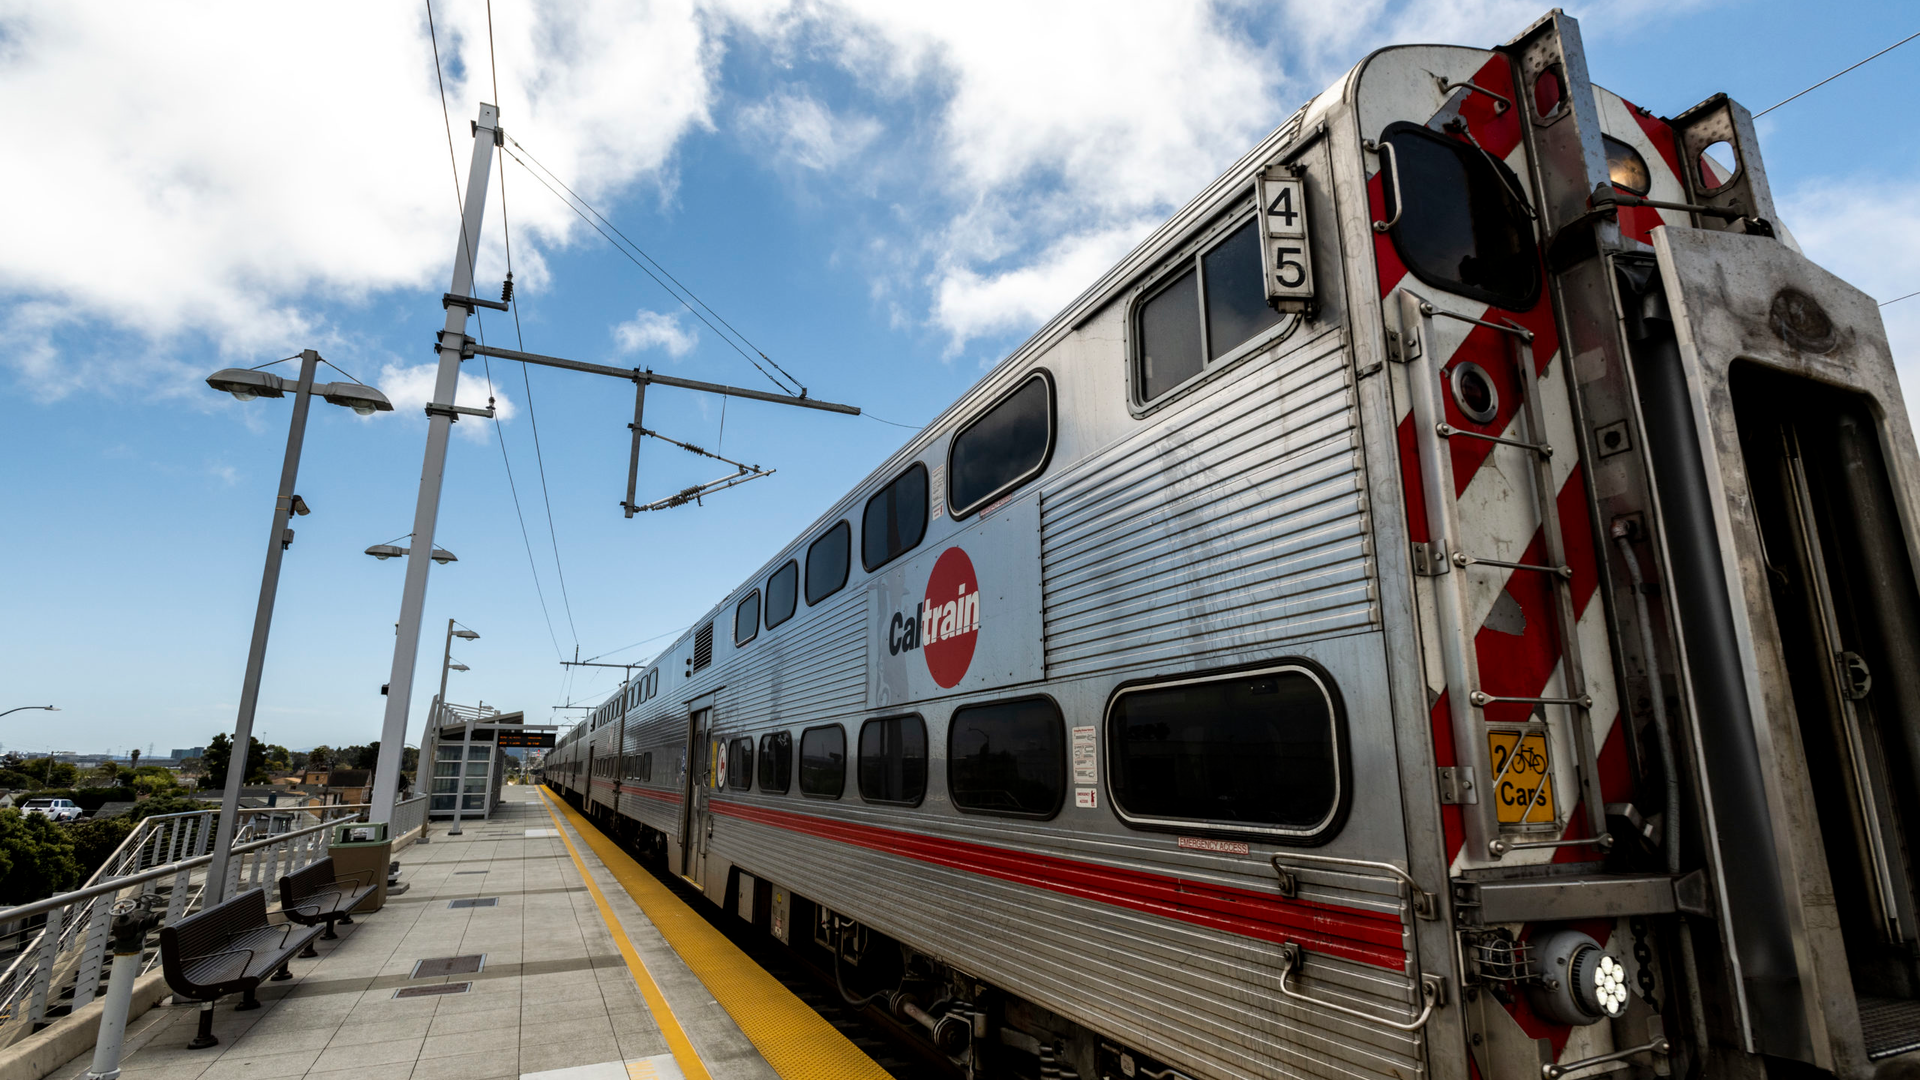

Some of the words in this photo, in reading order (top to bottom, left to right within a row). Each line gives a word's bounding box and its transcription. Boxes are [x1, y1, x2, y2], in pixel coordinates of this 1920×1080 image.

[889, 583, 979, 656] Caltrain
[1495, 745, 1509, 773] 2
[1501, 781, 1547, 806] Cars
[1180, 838, 1218, 849] EMERGENCY
[1220, 842, 1247, 853] ACCESS
